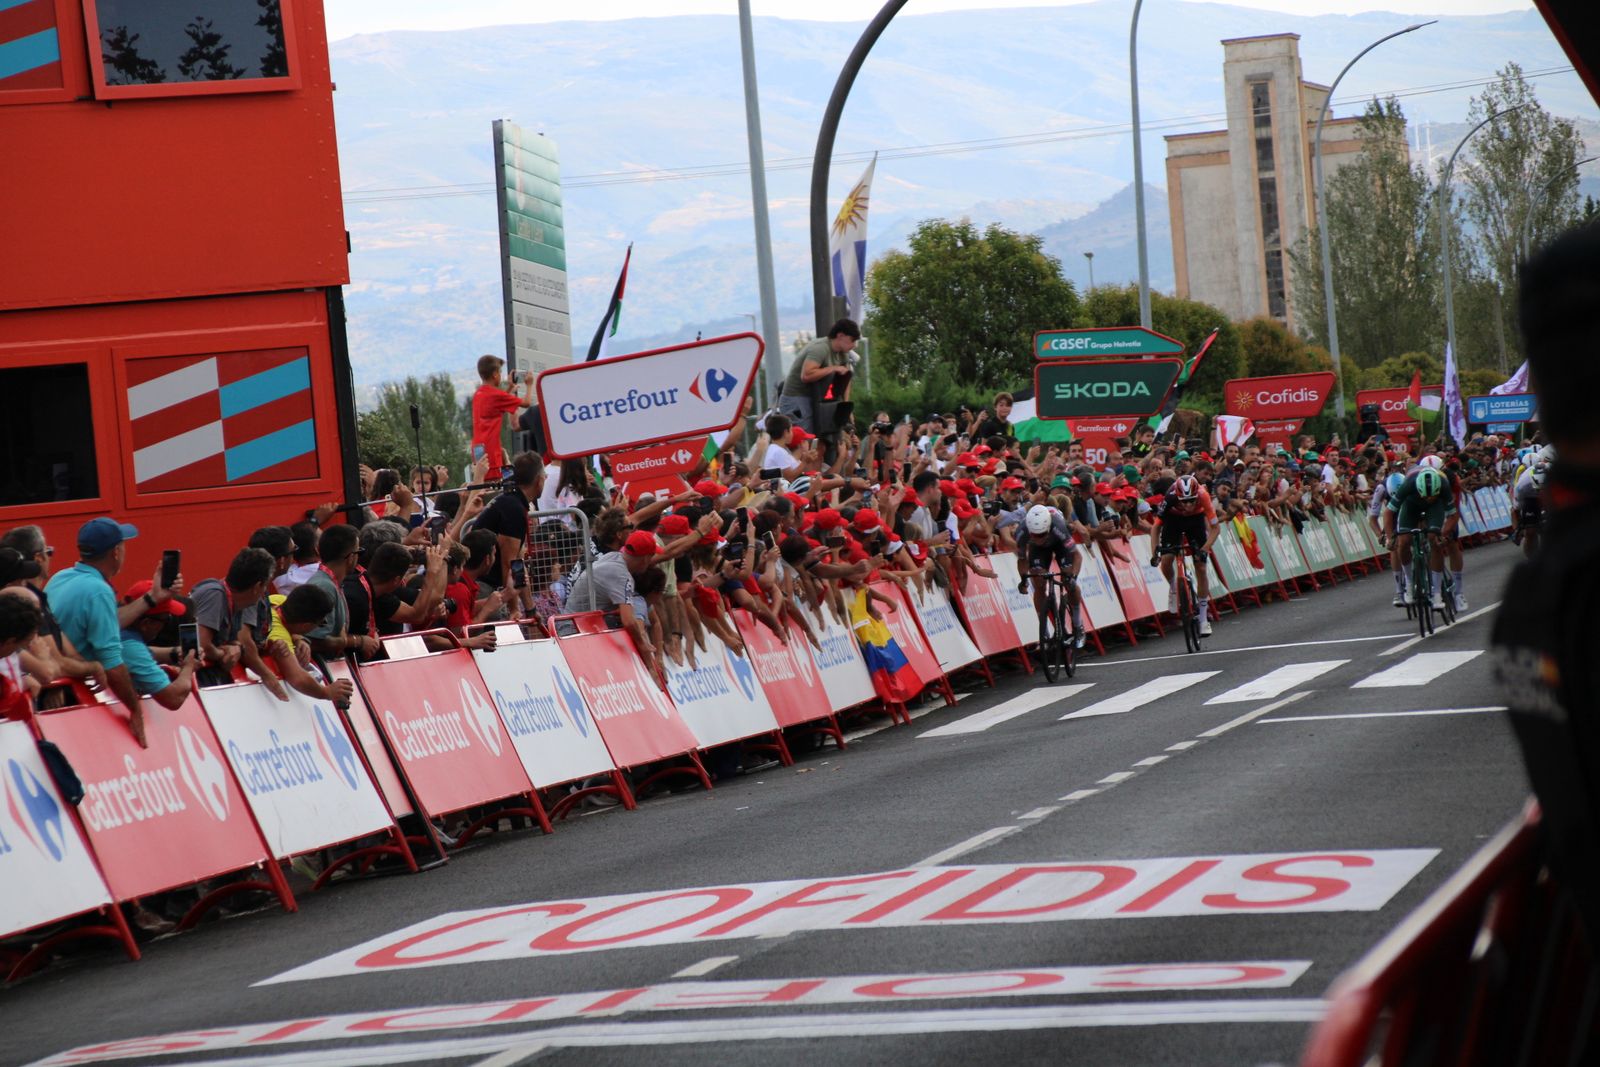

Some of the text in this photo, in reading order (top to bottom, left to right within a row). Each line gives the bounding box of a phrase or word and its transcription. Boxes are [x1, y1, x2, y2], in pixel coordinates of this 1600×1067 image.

[1051, 338, 1091, 350] caser
[559, 388, 679, 424] Carrefour
[1256, 388, 1320, 405] Cofidis
[616, 457, 667, 473] Carrefour
[1085, 448, 1107, 464] 50
[495, 682, 563, 738] Carrefour
[579, 669, 646, 721] Carrefour
[384, 699, 471, 762] Carrefour
[228, 729, 323, 796] Carrefour
[355, 855, 1375, 968] COFIDIS
